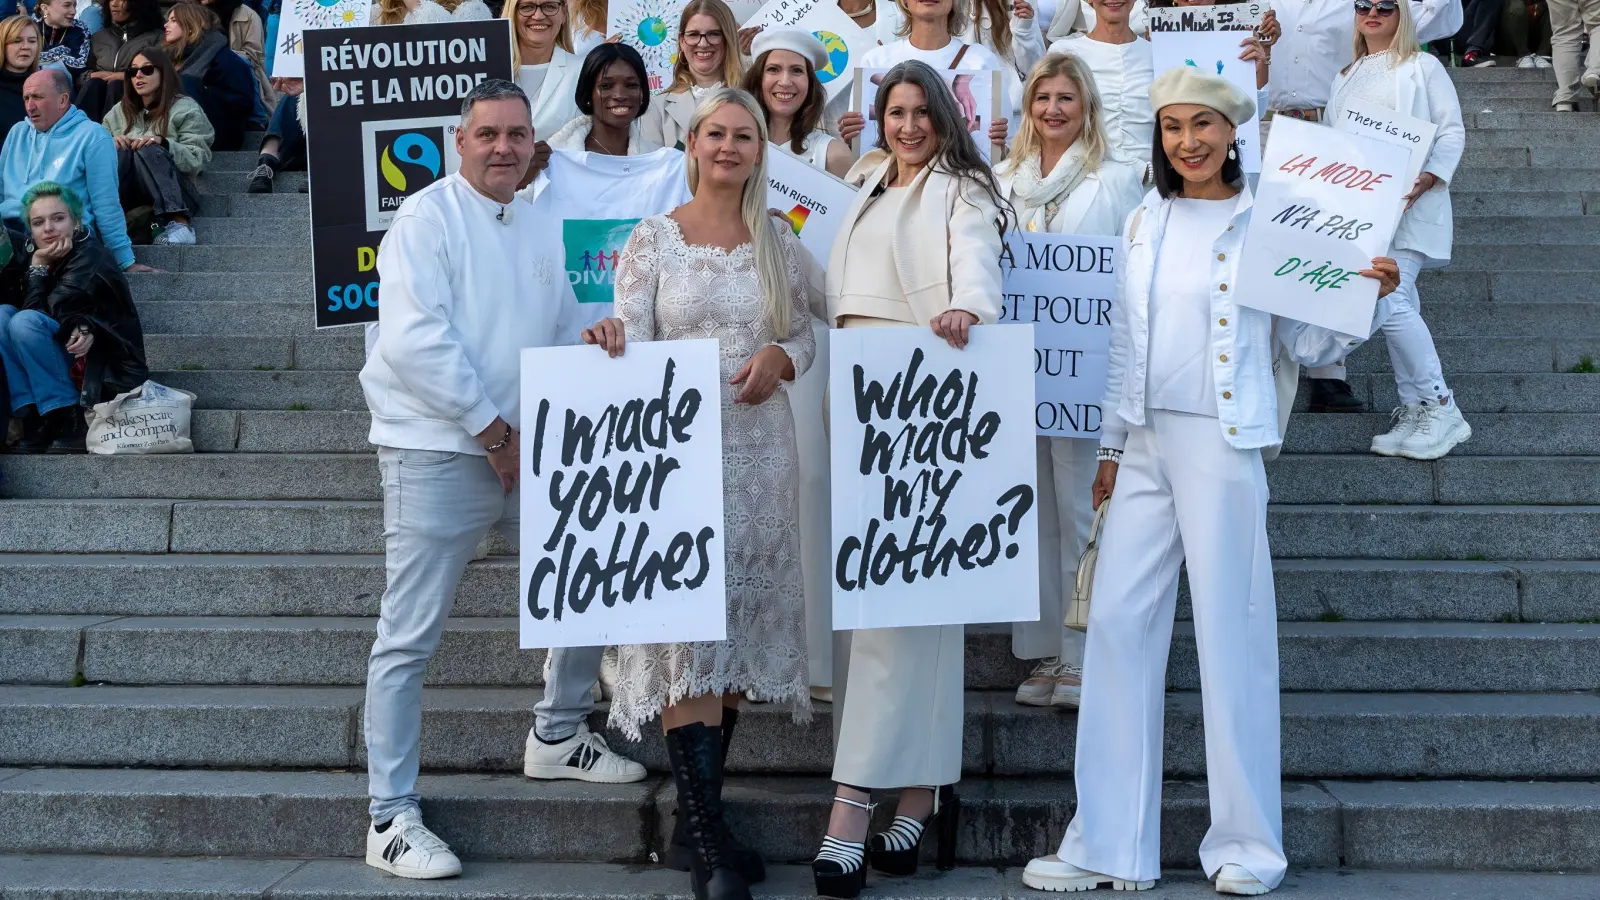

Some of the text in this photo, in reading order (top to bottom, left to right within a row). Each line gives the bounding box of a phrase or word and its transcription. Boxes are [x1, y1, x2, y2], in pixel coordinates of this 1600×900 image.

[320, 38, 486, 71] RÉVOLUTION
[330, 81, 364, 107] DE
[371, 79, 404, 104] LA
[1347, 109, 1421, 143] There is no
[1279, 154, 1392, 191] LA MODE
[767, 177, 828, 215] MAN RIGHTS
[1271, 204, 1373, 241] N'A PAS
[998, 241, 1114, 274] A MODE
[1274, 257, 1361, 292] D'ÂGE
[567, 270, 615, 285] DIVE
[327, 282, 379, 312] SOC
[1031, 294, 1112, 326] POUR
[853, 348, 964, 424] who
[100, 423, 179, 443] and Company
[105, 412, 174, 429] Shakespeare
[533, 357, 702, 477] I made
[859, 371, 1001, 476] made
[1035, 401, 1103, 433] OND
[543, 454, 681, 552] your
[883, 468, 963, 527] my
[835, 483, 1034, 592] clothes?
[527, 521, 715, 623] clothes
